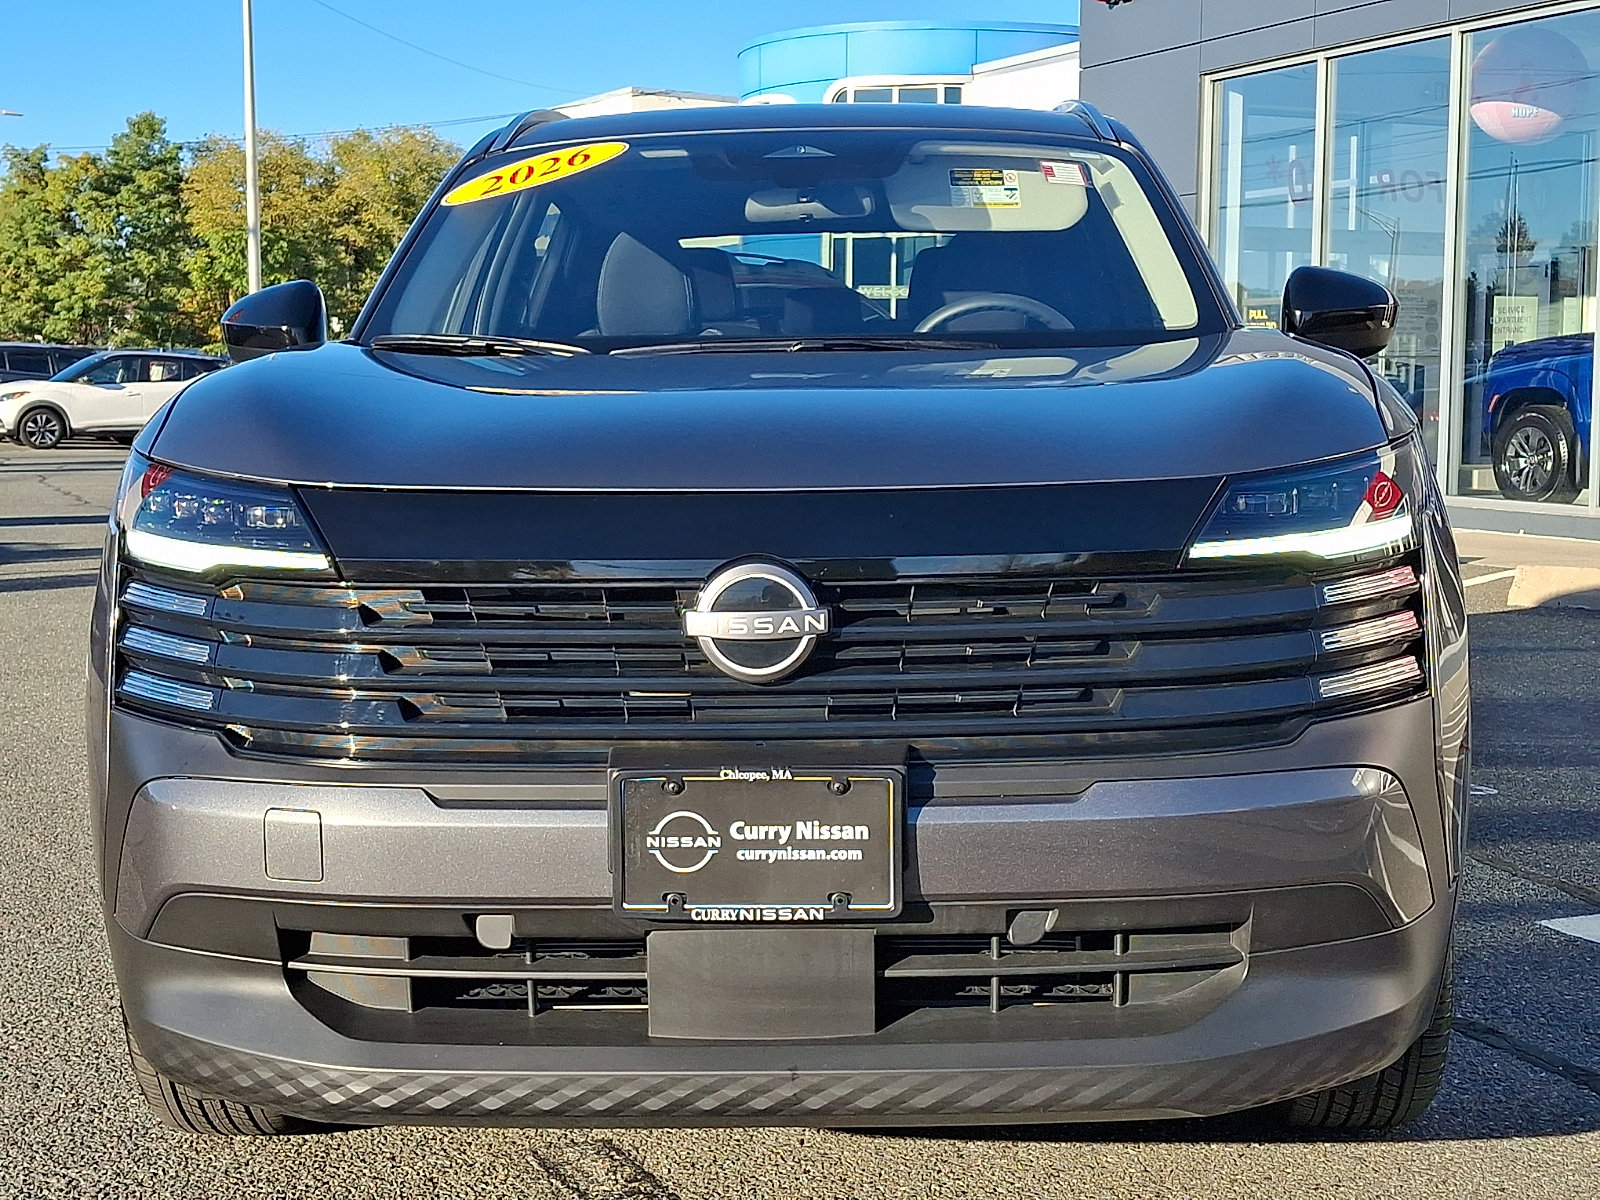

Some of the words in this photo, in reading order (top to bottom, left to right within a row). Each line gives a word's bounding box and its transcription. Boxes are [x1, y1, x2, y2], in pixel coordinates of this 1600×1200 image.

[480, 147, 592, 196] 2026
[1249, 309, 1269, 320] PULL
[719, 768, 770, 782] Chicopee,
[771, 769, 793, 780] MA
[729, 821, 792, 844] Curry
[795, 820, 870, 841] Nissan
[646, 836, 722, 849] NISSAN
[736, 846, 863, 863] currynissan.com
